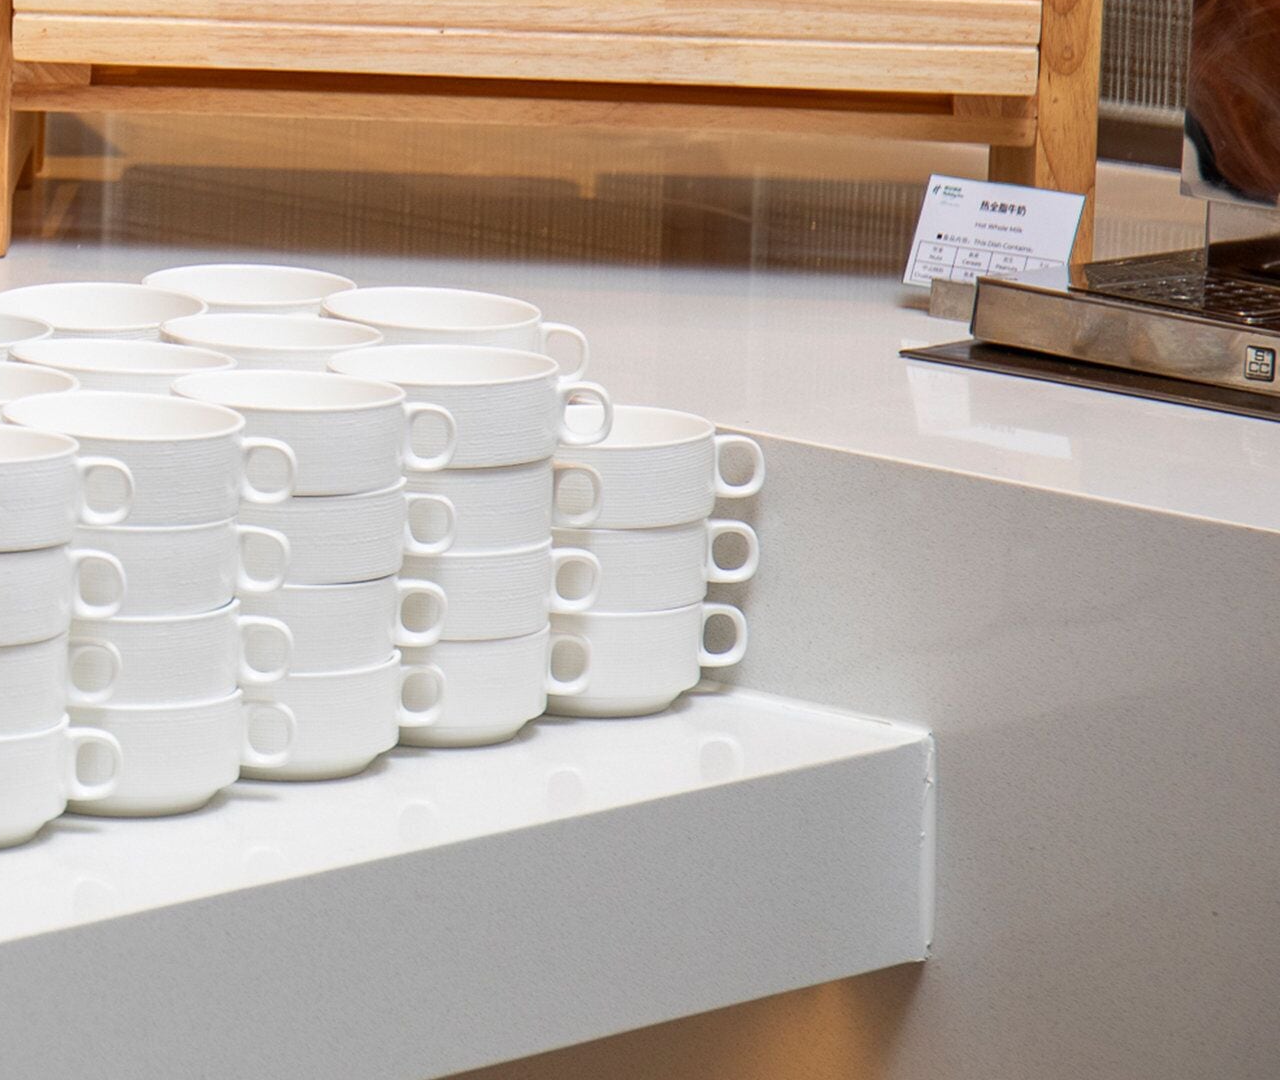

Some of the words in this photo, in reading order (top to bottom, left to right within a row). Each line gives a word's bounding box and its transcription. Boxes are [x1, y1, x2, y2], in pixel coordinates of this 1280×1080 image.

[979, 199, 1027, 217] 热全脂牛奶
[988, 223, 1009, 232] Whole
[1009, 226, 1023, 234] Milk
[973, 237, 987, 247] This
[987, 240, 1002, 250] Dish
